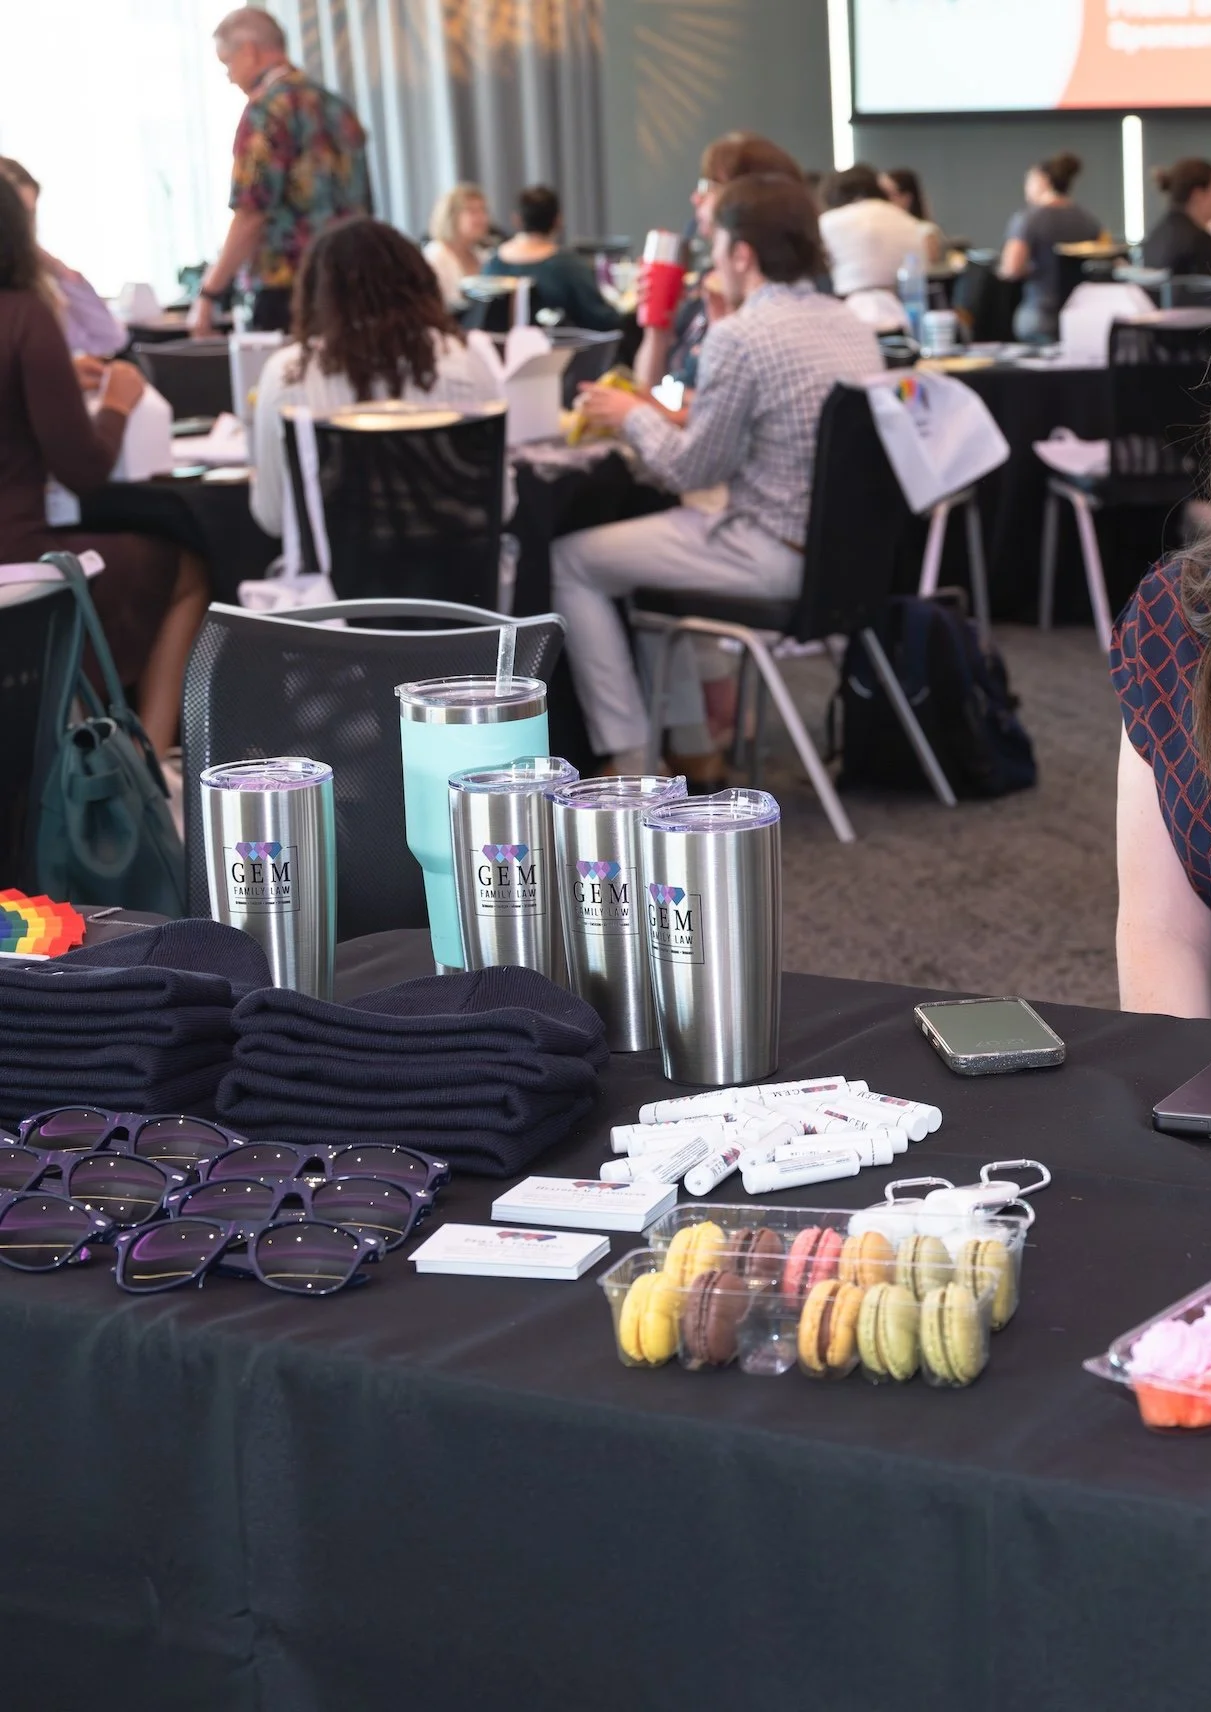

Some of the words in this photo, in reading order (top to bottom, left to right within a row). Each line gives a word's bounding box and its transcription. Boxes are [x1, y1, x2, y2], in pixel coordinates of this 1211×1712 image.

[232, 861, 291, 884] GEM
[478, 864, 537, 886] GEM
[234, 886, 265, 896] FAMILY
[270, 885, 290, 895] LAW
[480, 889, 511, 899] FAMILY
[516, 888, 536, 898] LAW
[573, 880, 630, 904] GEM
[608, 907, 629, 917] LAW
[648, 903, 694, 932] GEM
[674, 935, 693, 945] LAW
[772, 1088, 801, 1098] GEM
